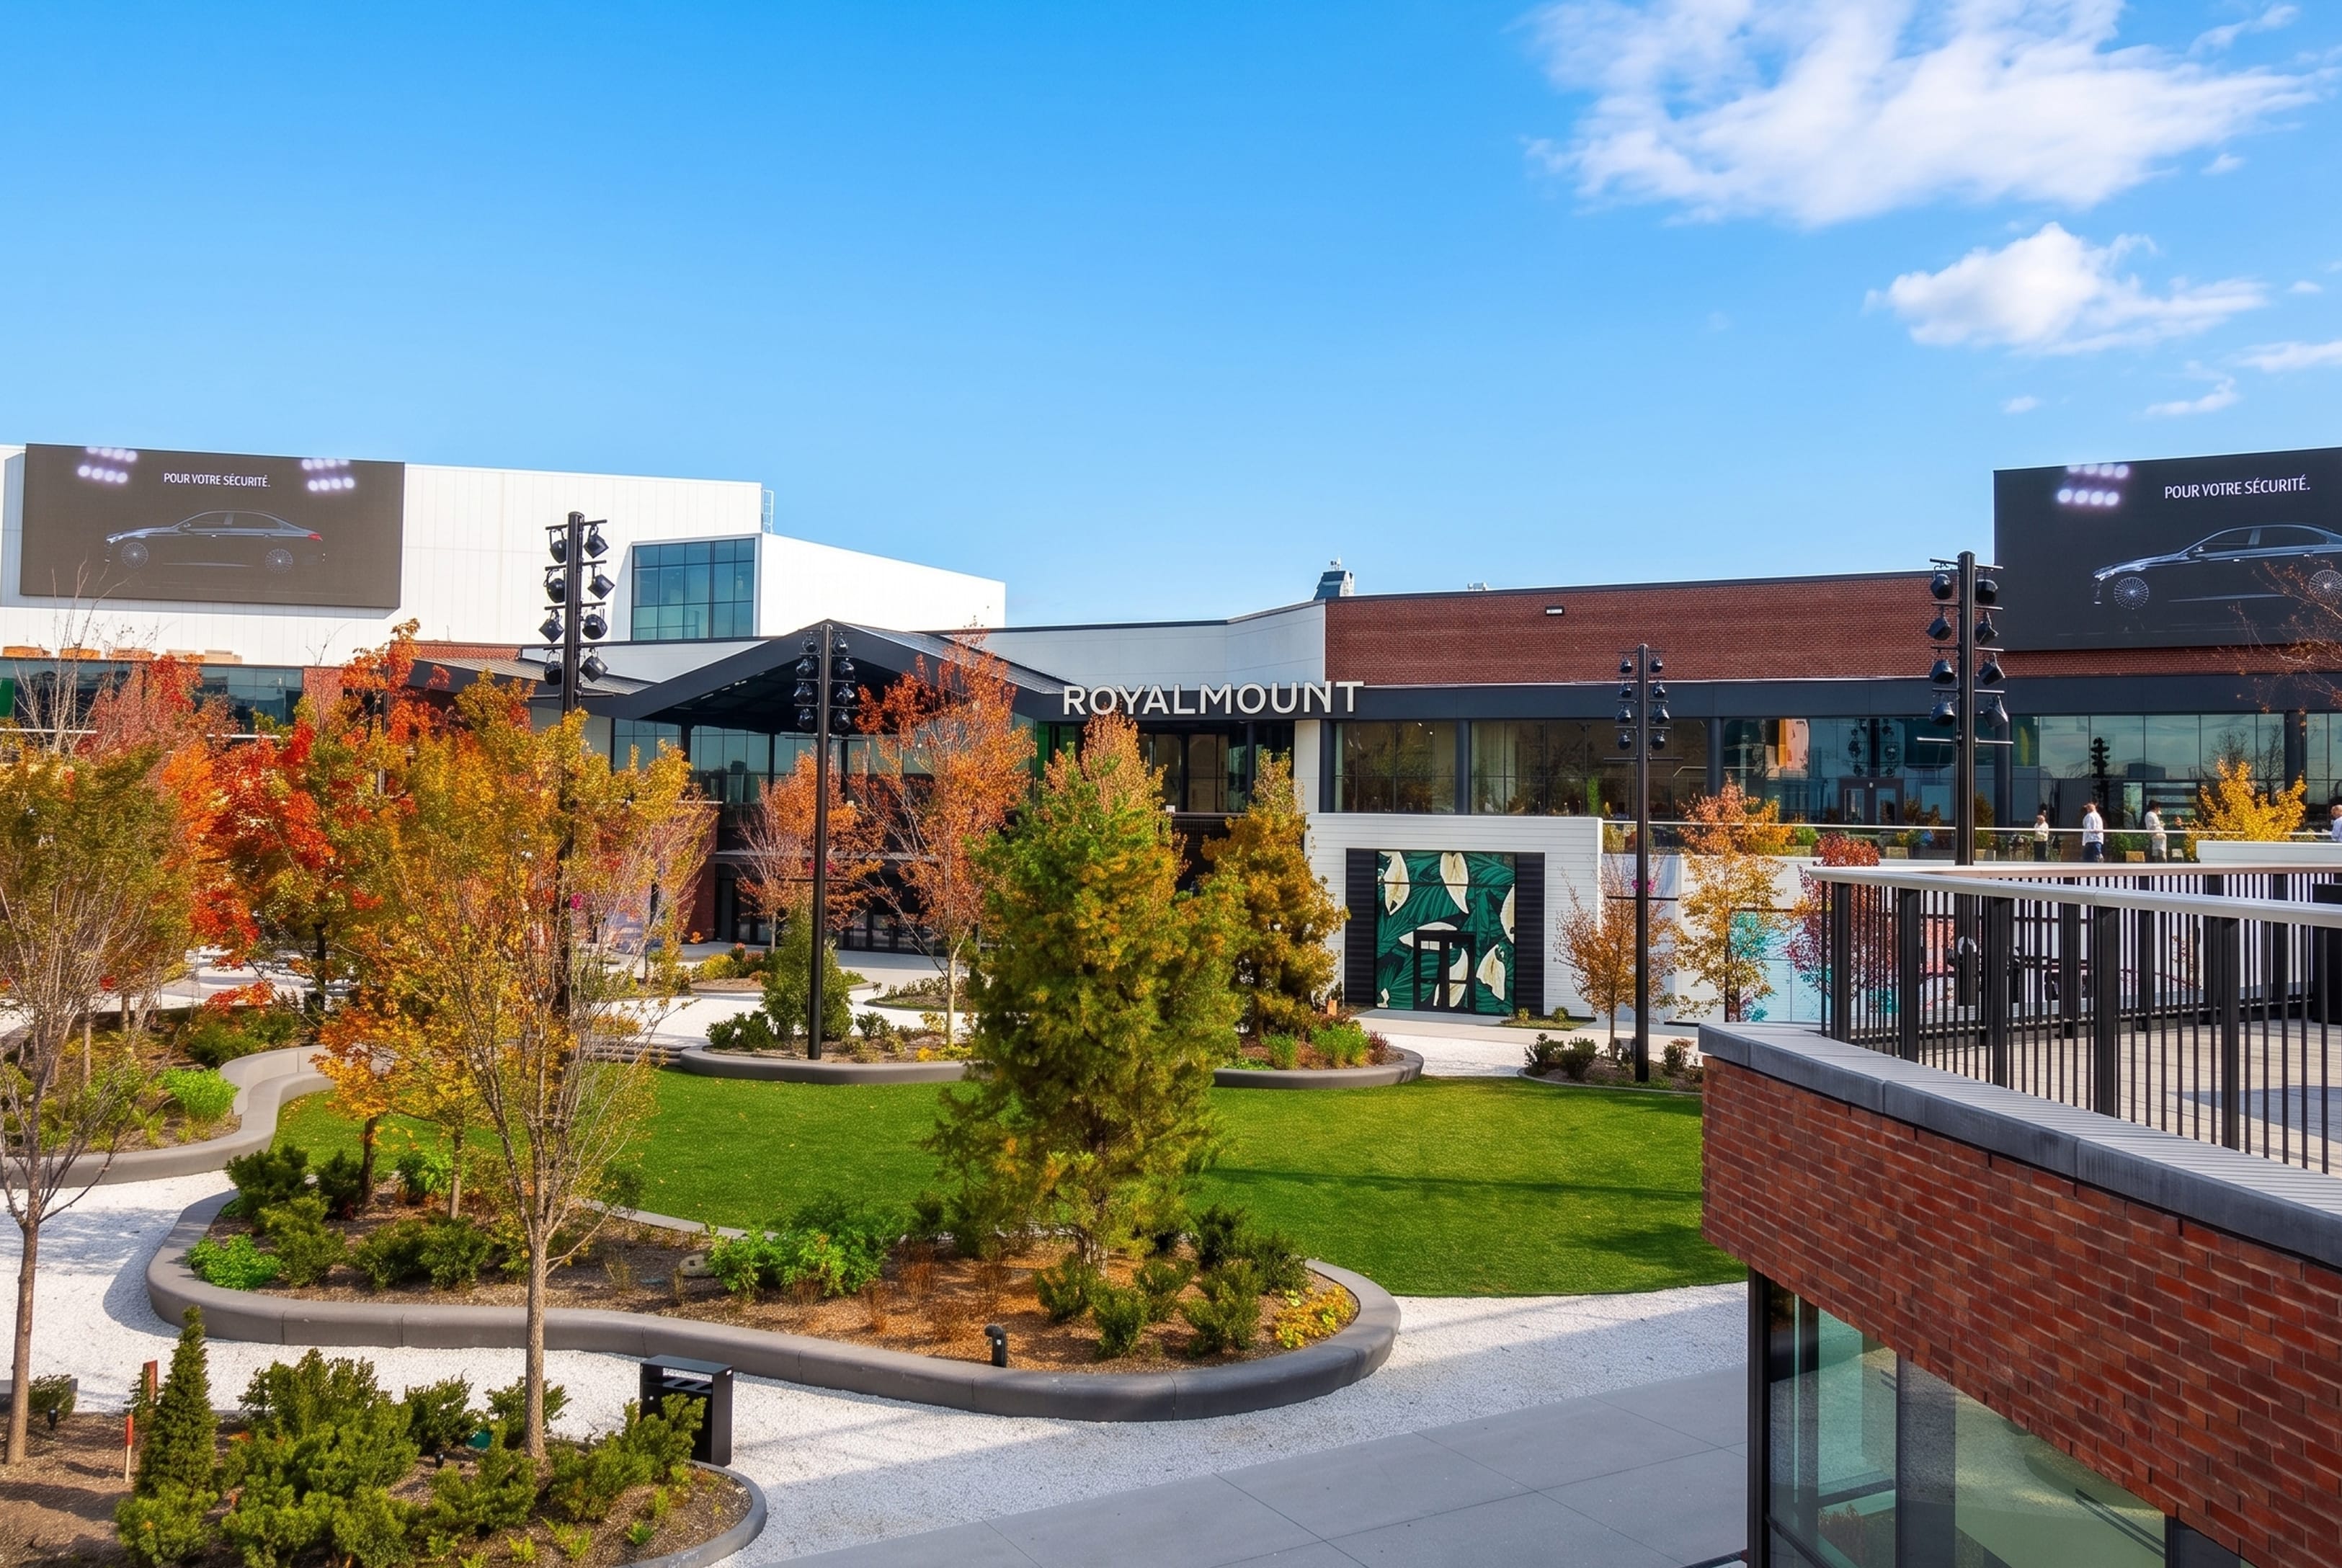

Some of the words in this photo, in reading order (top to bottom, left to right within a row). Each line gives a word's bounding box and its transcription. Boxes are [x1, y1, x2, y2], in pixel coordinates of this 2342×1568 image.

[164, 473, 190, 484] POUR
[192, 474, 221, 485] VOTRE
[223, 473, 271, 487] SÉCURITÉ.
[2165, 484, 2200, 499] POUR
[2201, 481, 2242, 496] VOTRE
[2245, 473, 2311, 494] SÉCURITÉ.
[1063, 680, 1365, 716] ROYALMOUNT
